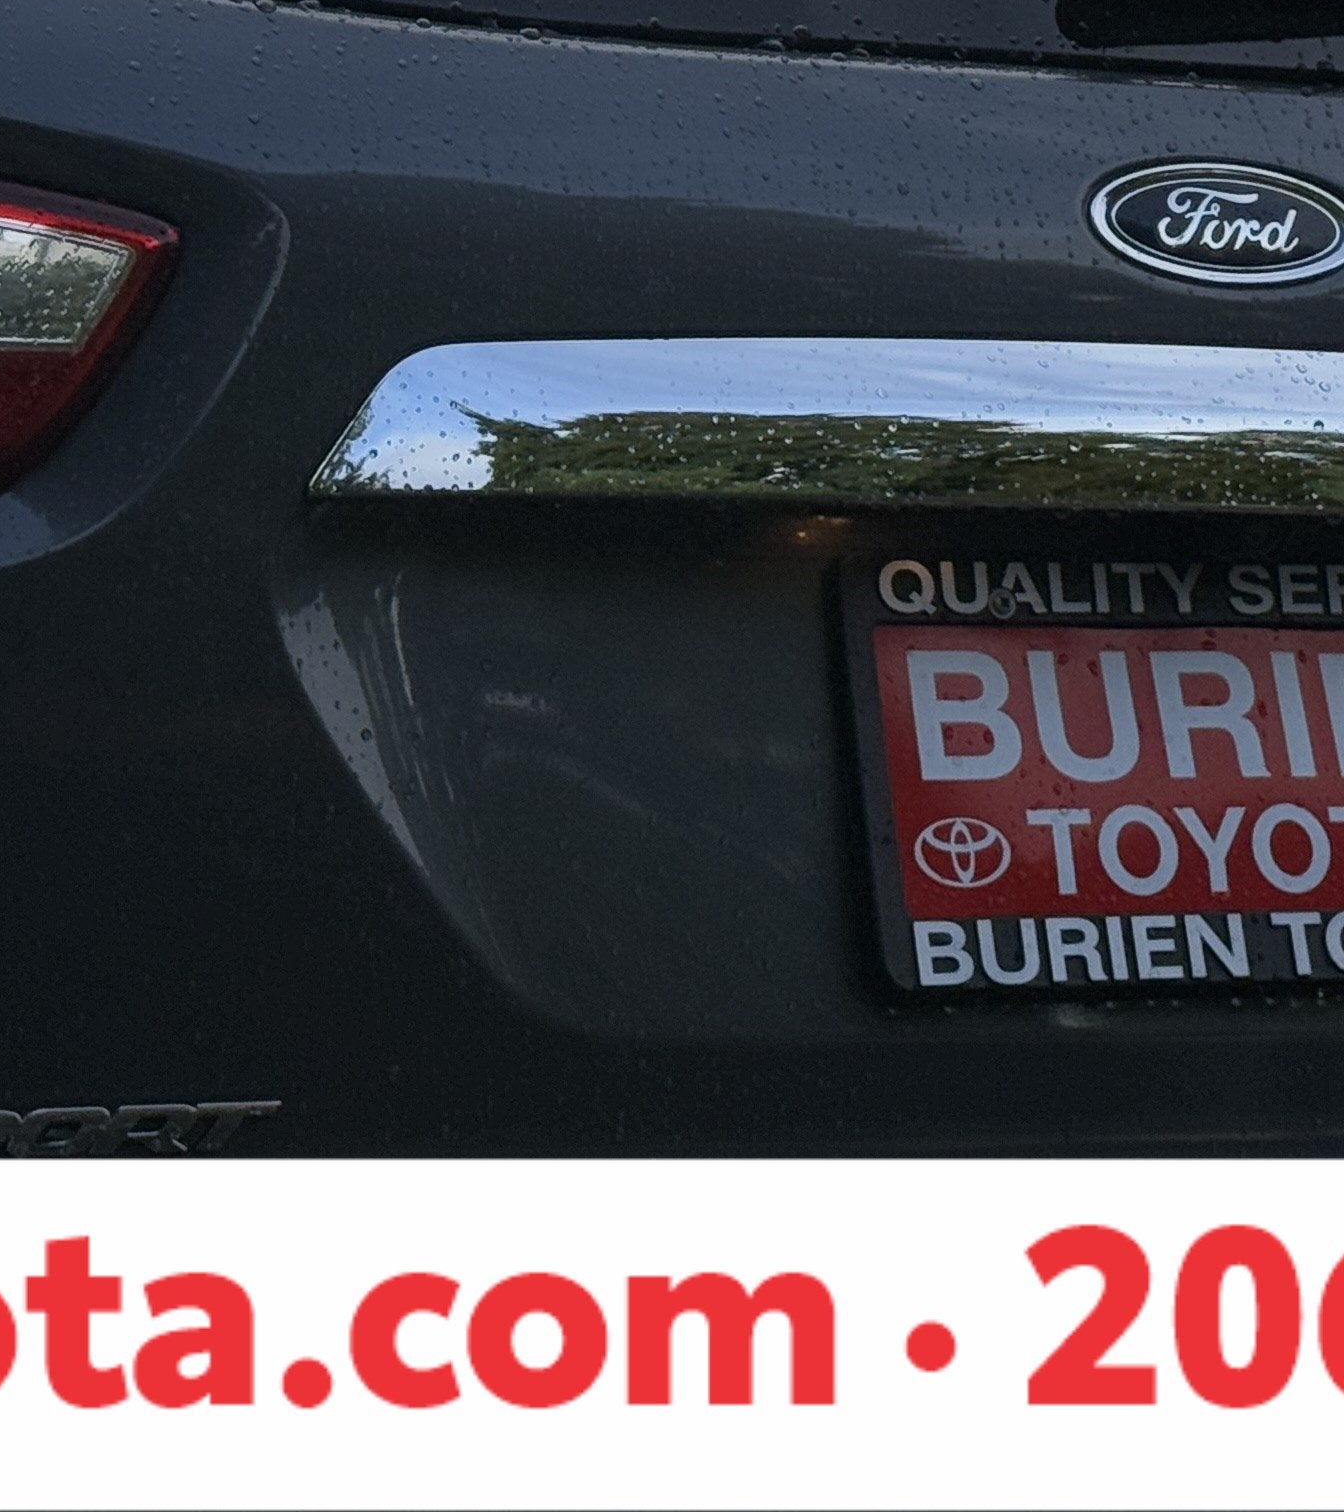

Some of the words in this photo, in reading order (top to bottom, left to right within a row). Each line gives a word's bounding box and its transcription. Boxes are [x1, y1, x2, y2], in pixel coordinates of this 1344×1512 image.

[1157, 186, 1299, 253] Ford
[878, 559, 1203, 617] QUALITY
[913, 912, 1251, 988] BURIEN
